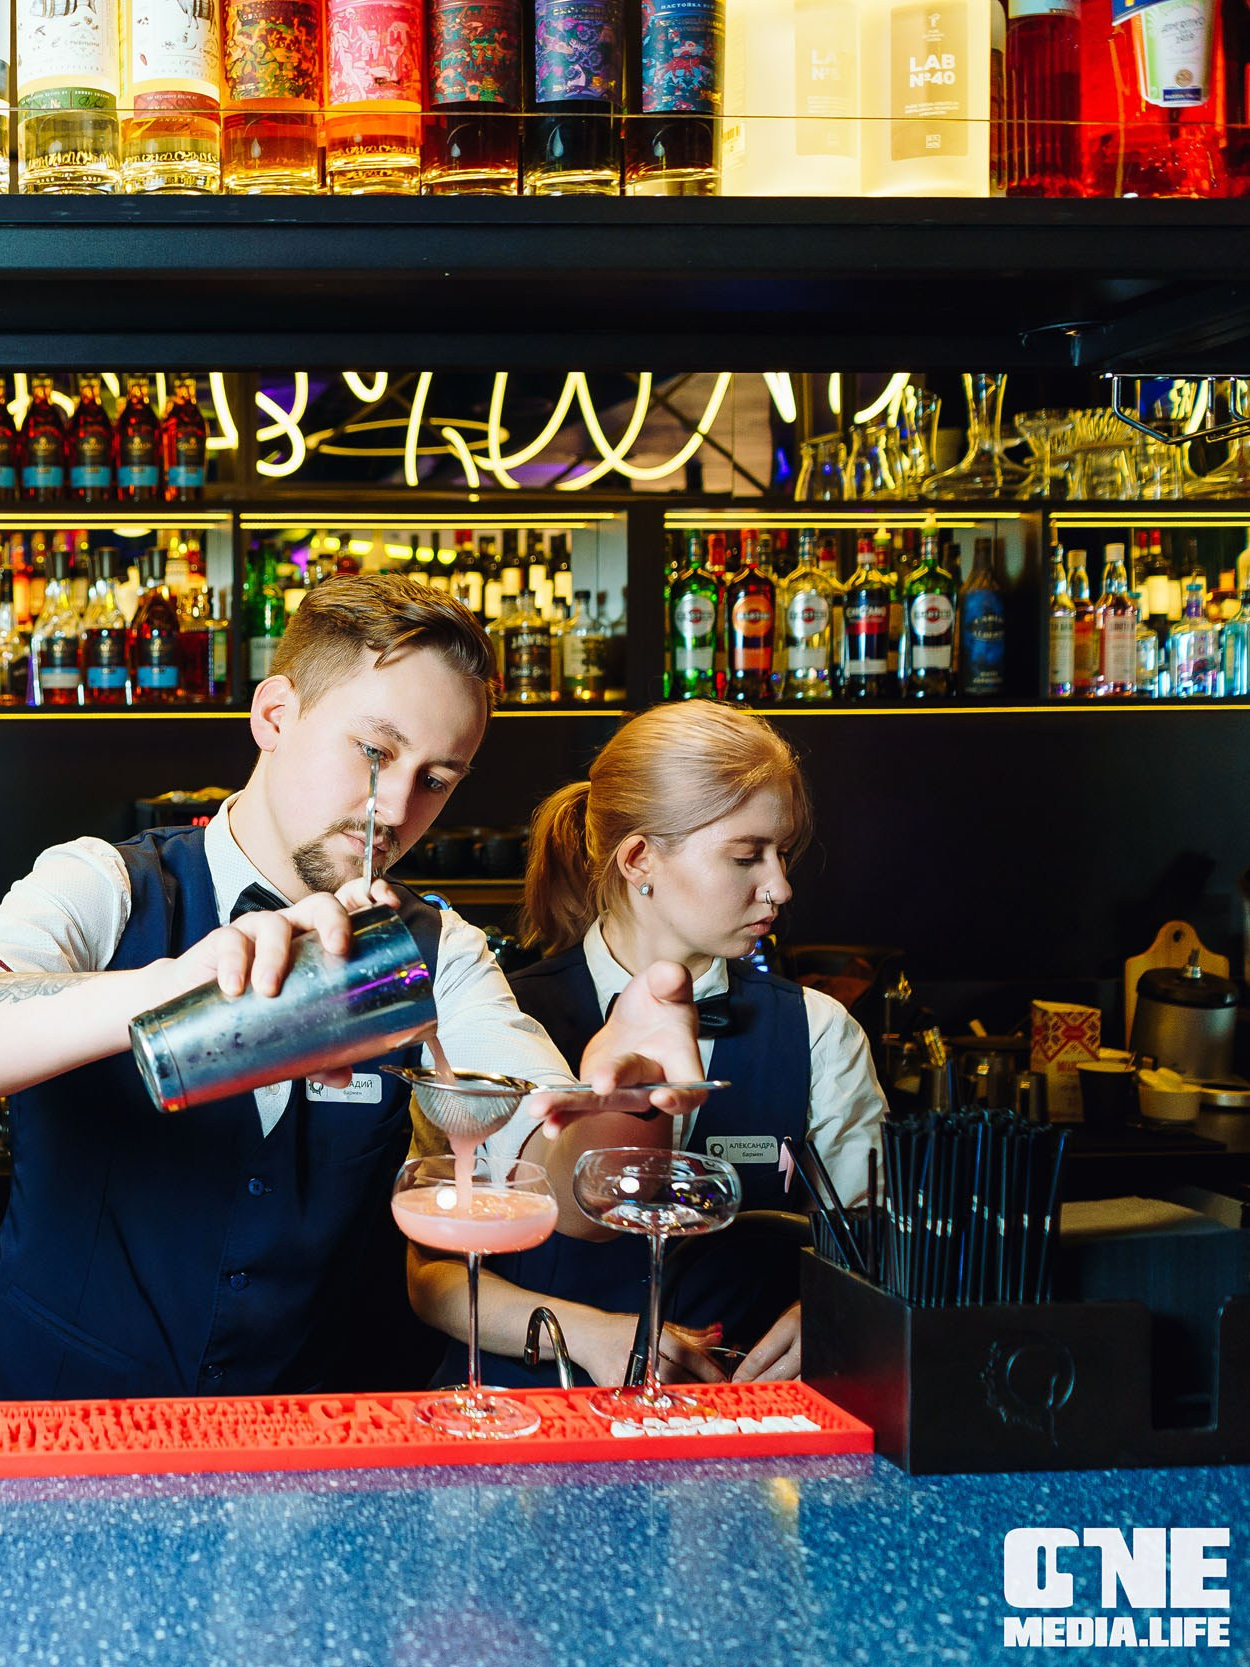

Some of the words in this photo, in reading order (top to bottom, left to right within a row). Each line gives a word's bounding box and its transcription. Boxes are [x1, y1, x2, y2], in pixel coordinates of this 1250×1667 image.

[909, 53, 956, 72] LAB
[349, 1079, 373, 1088] АДИЙ
[729, 1142, 775, 1150] АЛЕКСАНДРА
